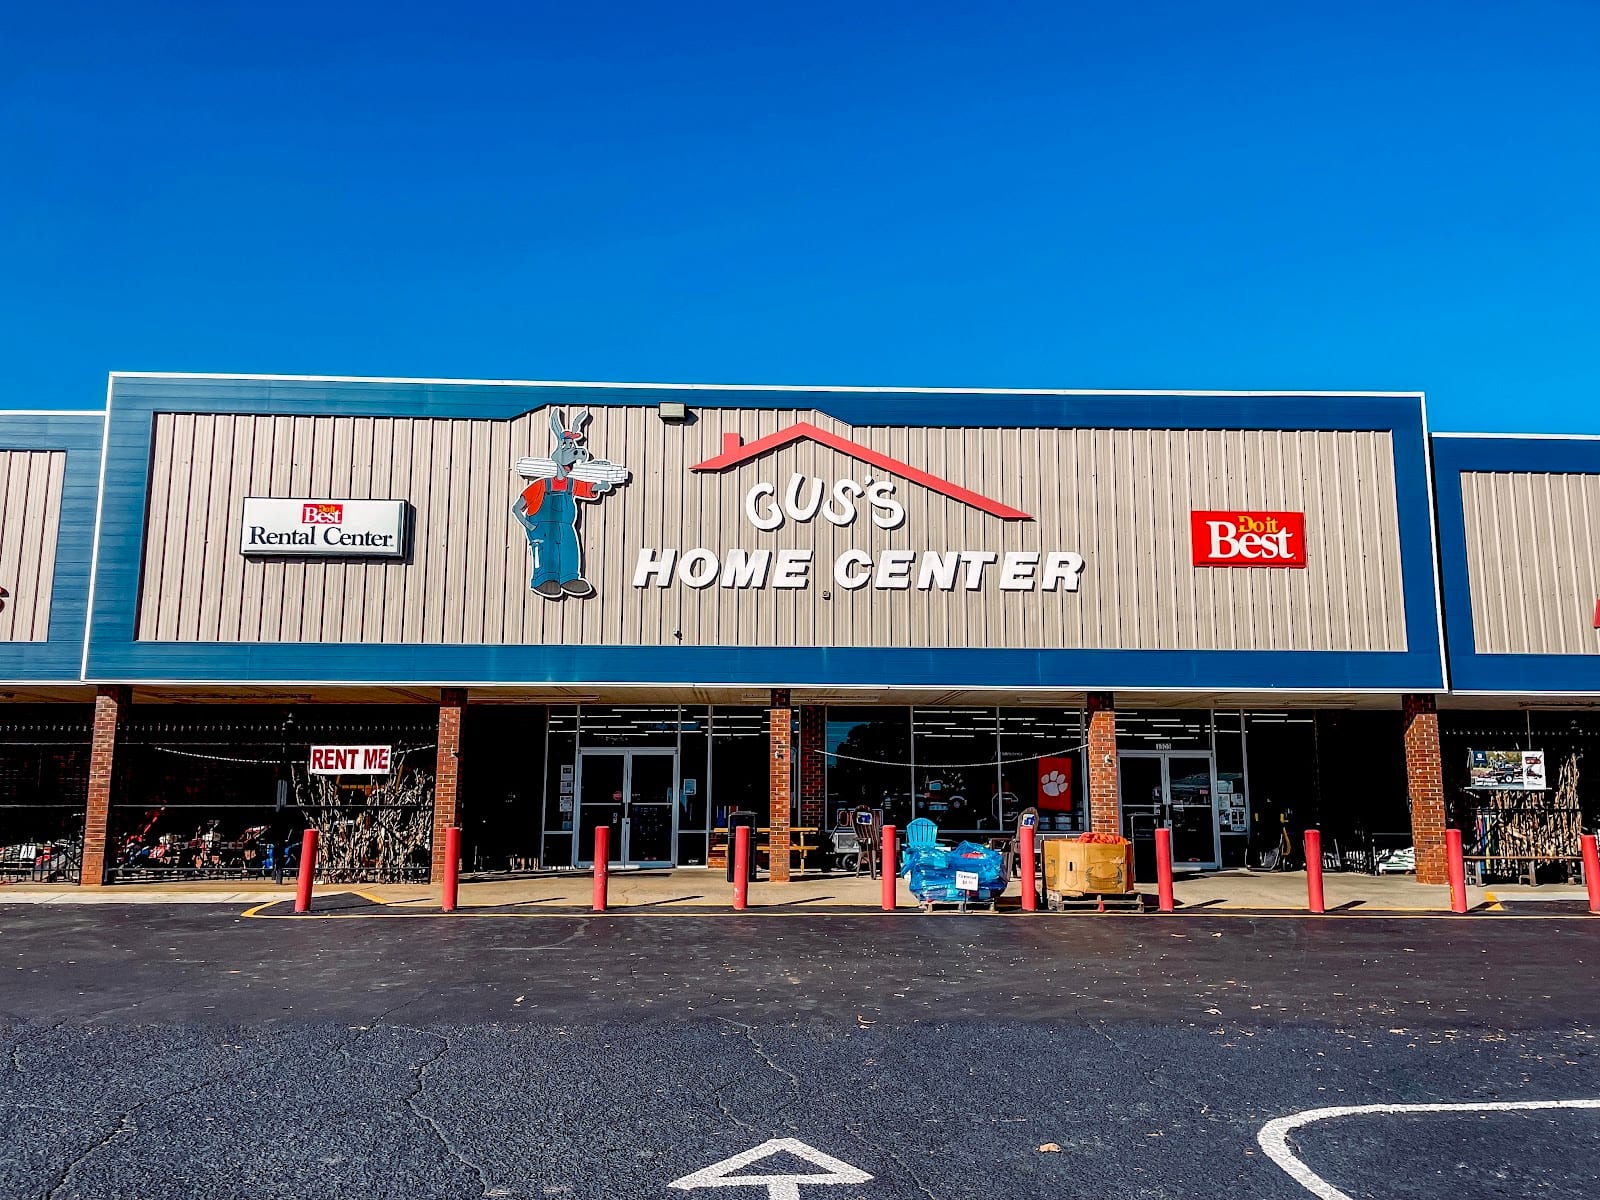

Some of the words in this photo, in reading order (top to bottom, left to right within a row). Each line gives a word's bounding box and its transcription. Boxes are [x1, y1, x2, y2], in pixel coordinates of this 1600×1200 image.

[745, 473, 904, 530] GUS'S
[304, 507, 341, 523] Best
[1237, 515, 1264, 533] Do
[1265, 516, 1279, 533] it
[249, 526, 316, 545] Rental
[324, 527, 392, 547] Center
[1205, 521, 1295, 559] Best
[632, 548, 814, 590] HOME
[833, 549, 1084, 592] CENTER
[312, 748, 360, 770] RENT
[363, 748, 390, 770] ME
